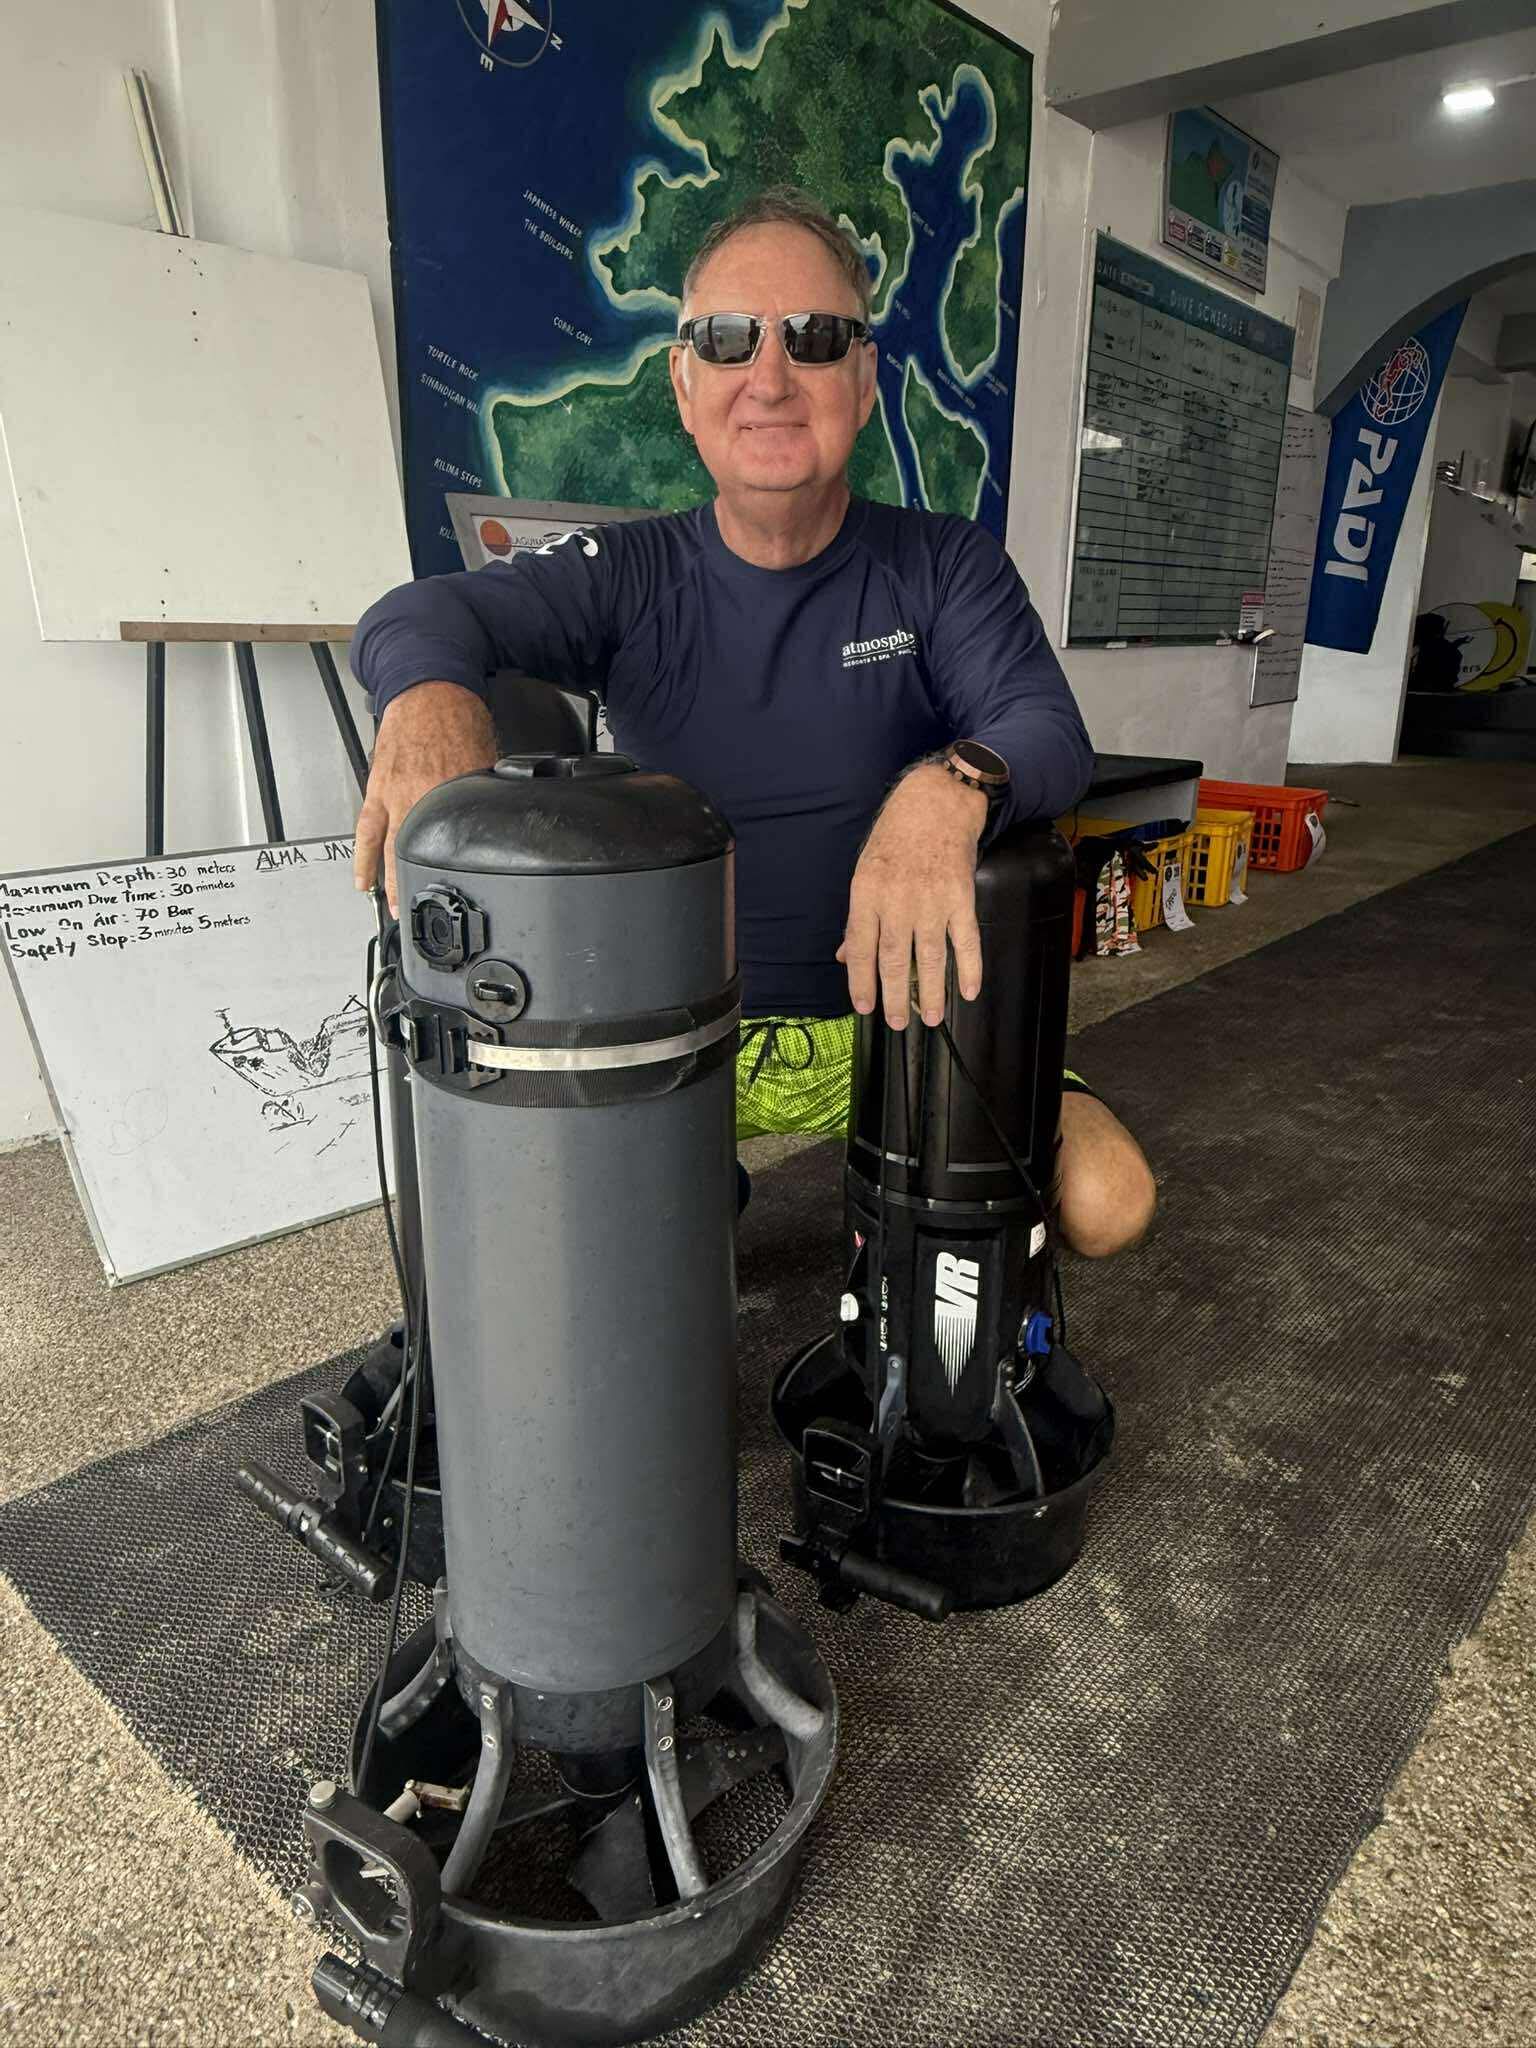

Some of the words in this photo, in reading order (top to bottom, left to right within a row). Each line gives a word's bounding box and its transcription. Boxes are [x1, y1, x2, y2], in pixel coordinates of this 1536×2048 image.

[522, 189, 558, 220] JAPANESE
[559, 215, 583, 239] WRECK
[524, 218, 539, 238] THE
[539, 230, 575, 260] BOULDERS
[1169, 288, 1195, 315] DIVE
[553, 316, 575, 336] CORAL
[575, 330, 594, 347] COVE
[428, 344, 458, 369] TURTLE
[458, 363, 481, 382] ROCK
[433, 457, 460, 478] KILIMA
[460, 470, 484, 489] STEPS
[1324, 428, 1399, 581] PADI
[256, 846, 307, 870] ALMA
[314, 841, 355, 861] JAN
[0, 882, 91, 898] Maximum
[97, 865, 162, 889] Depth:
[166, 866, 187, 879] 30
[197, 860, 236, 875] meters
[0, 899, 84, 918] Maximum
[88, 894, 118, 905] Dive
[170, 883, 194, 897] 30
[195, 879, 236, 893] minutes
[4, 921, 46, 940] Low
[134, 907, 159, 922] 70
[167, 905, 195, 918] Bar
[10, 936, 76, 961] Safety
[137, 926, 153, 941] 3
[199, 915, 212, 930] 5
[213, 914, 251, 929] meters
